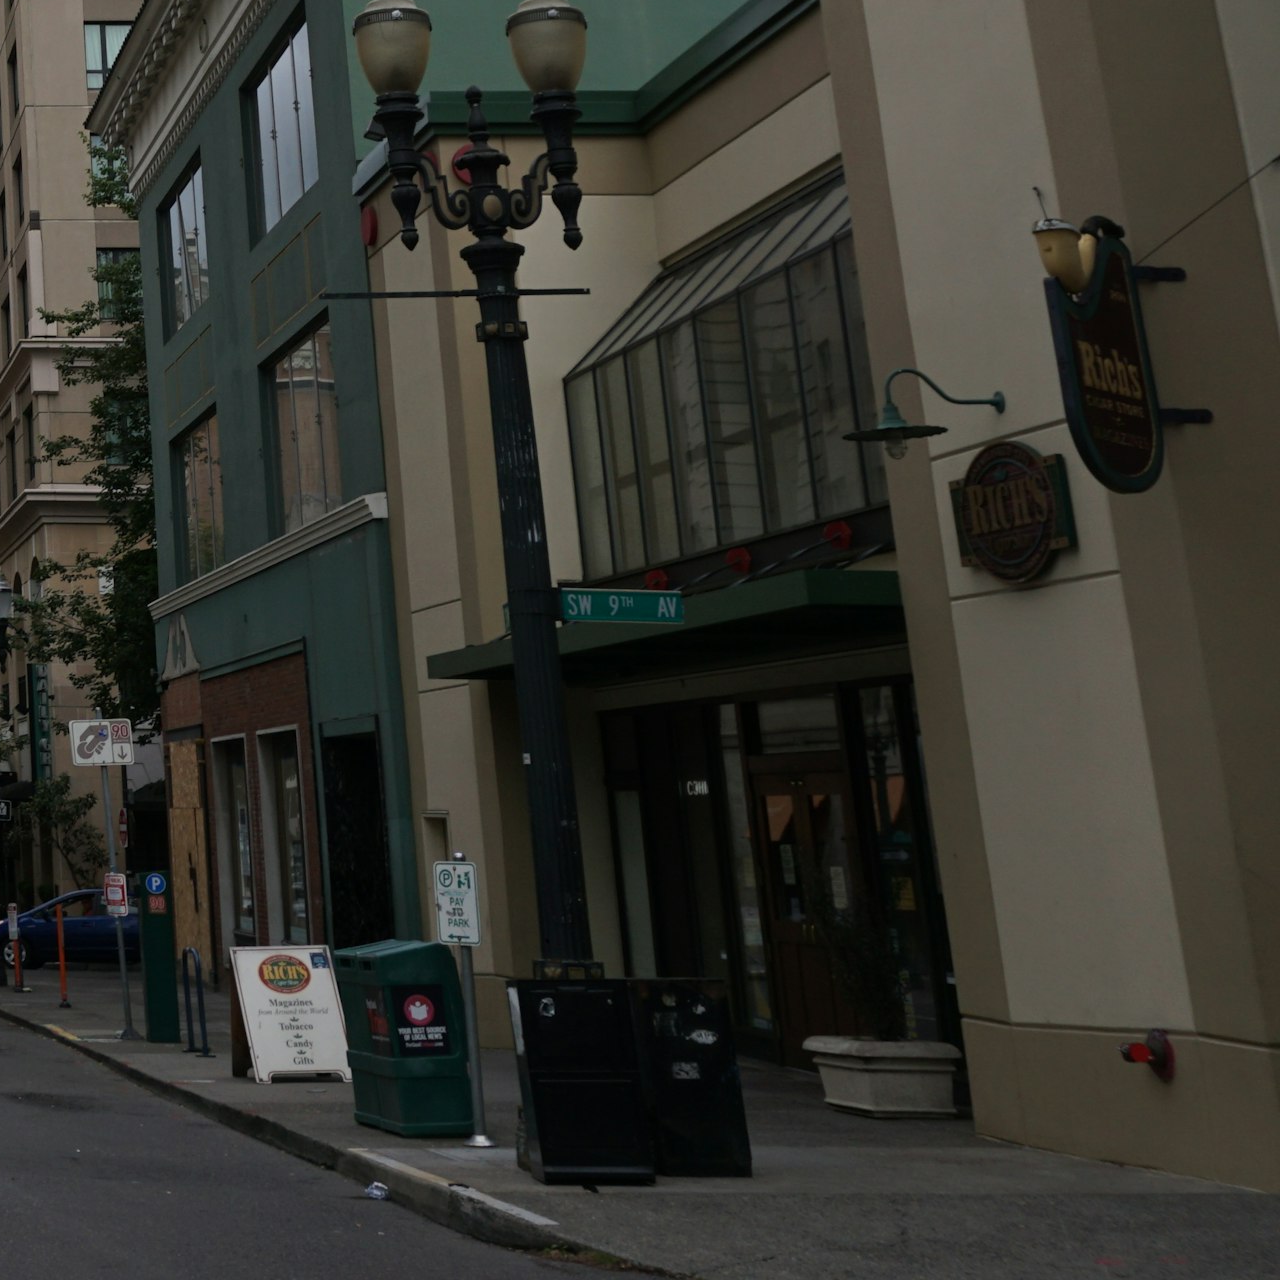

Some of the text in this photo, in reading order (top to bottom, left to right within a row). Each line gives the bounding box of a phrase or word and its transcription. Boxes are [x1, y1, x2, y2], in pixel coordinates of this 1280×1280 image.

[1076, 339, 1143, 402] Rich's
[966, 474, 1048, 536] RICH'S
[567, 594, 677, 618] SW 9TH AV
[111, 724, 129, 738] 90
[449, 897, 464, 906] PAY
[452, 908, 463, 917] TO
[448, 918, 469, 928] PARK
[262, 964, 309, 980] RICH'S
[269, 999, 313, 1008] Magazines
[279, 1023, 313, 1031] Tobacco
[286, 1040, 313, 1049] Candy
[293, 1056, 314, 1065] Gifts
